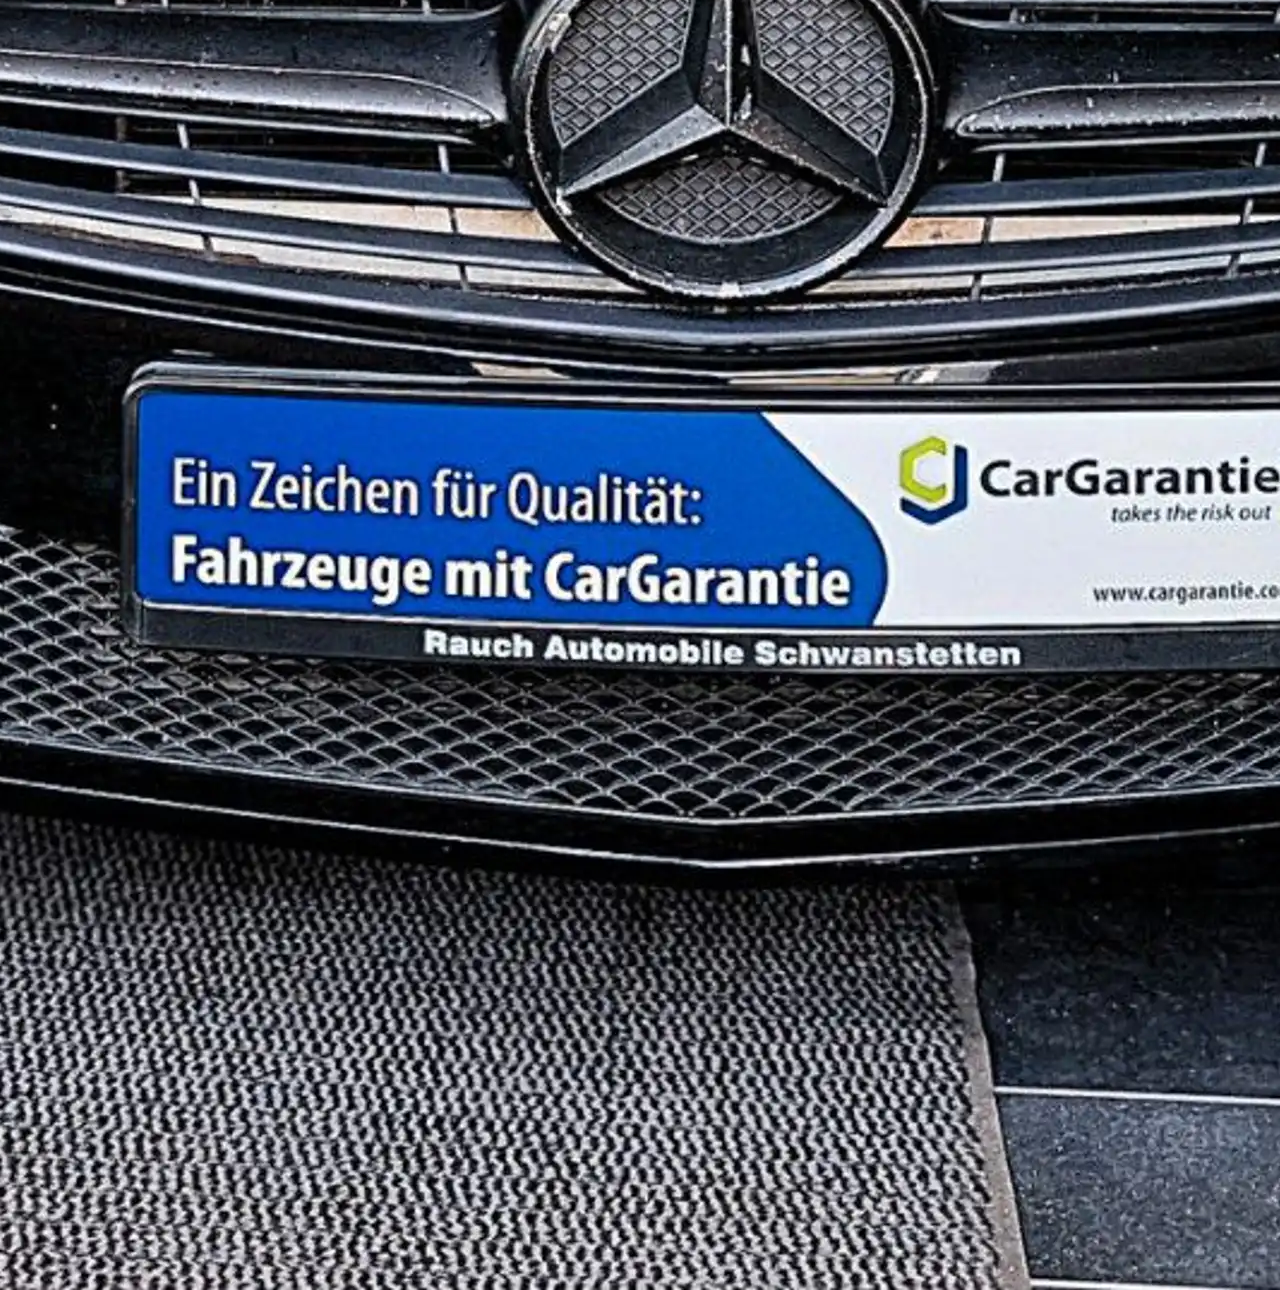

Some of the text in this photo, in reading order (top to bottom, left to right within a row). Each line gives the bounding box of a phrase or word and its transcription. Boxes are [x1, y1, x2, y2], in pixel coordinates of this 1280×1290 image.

[173, 456, 702, 526] Ein Zeichen für Qualität:
[1111, 503, 1272, 523] takes the risk out
[171, 533, 852, 607] Fahrzeuge mit CarGarantie
[423, 628, 1022, 667] Rauch Automobile Schwanstetten
